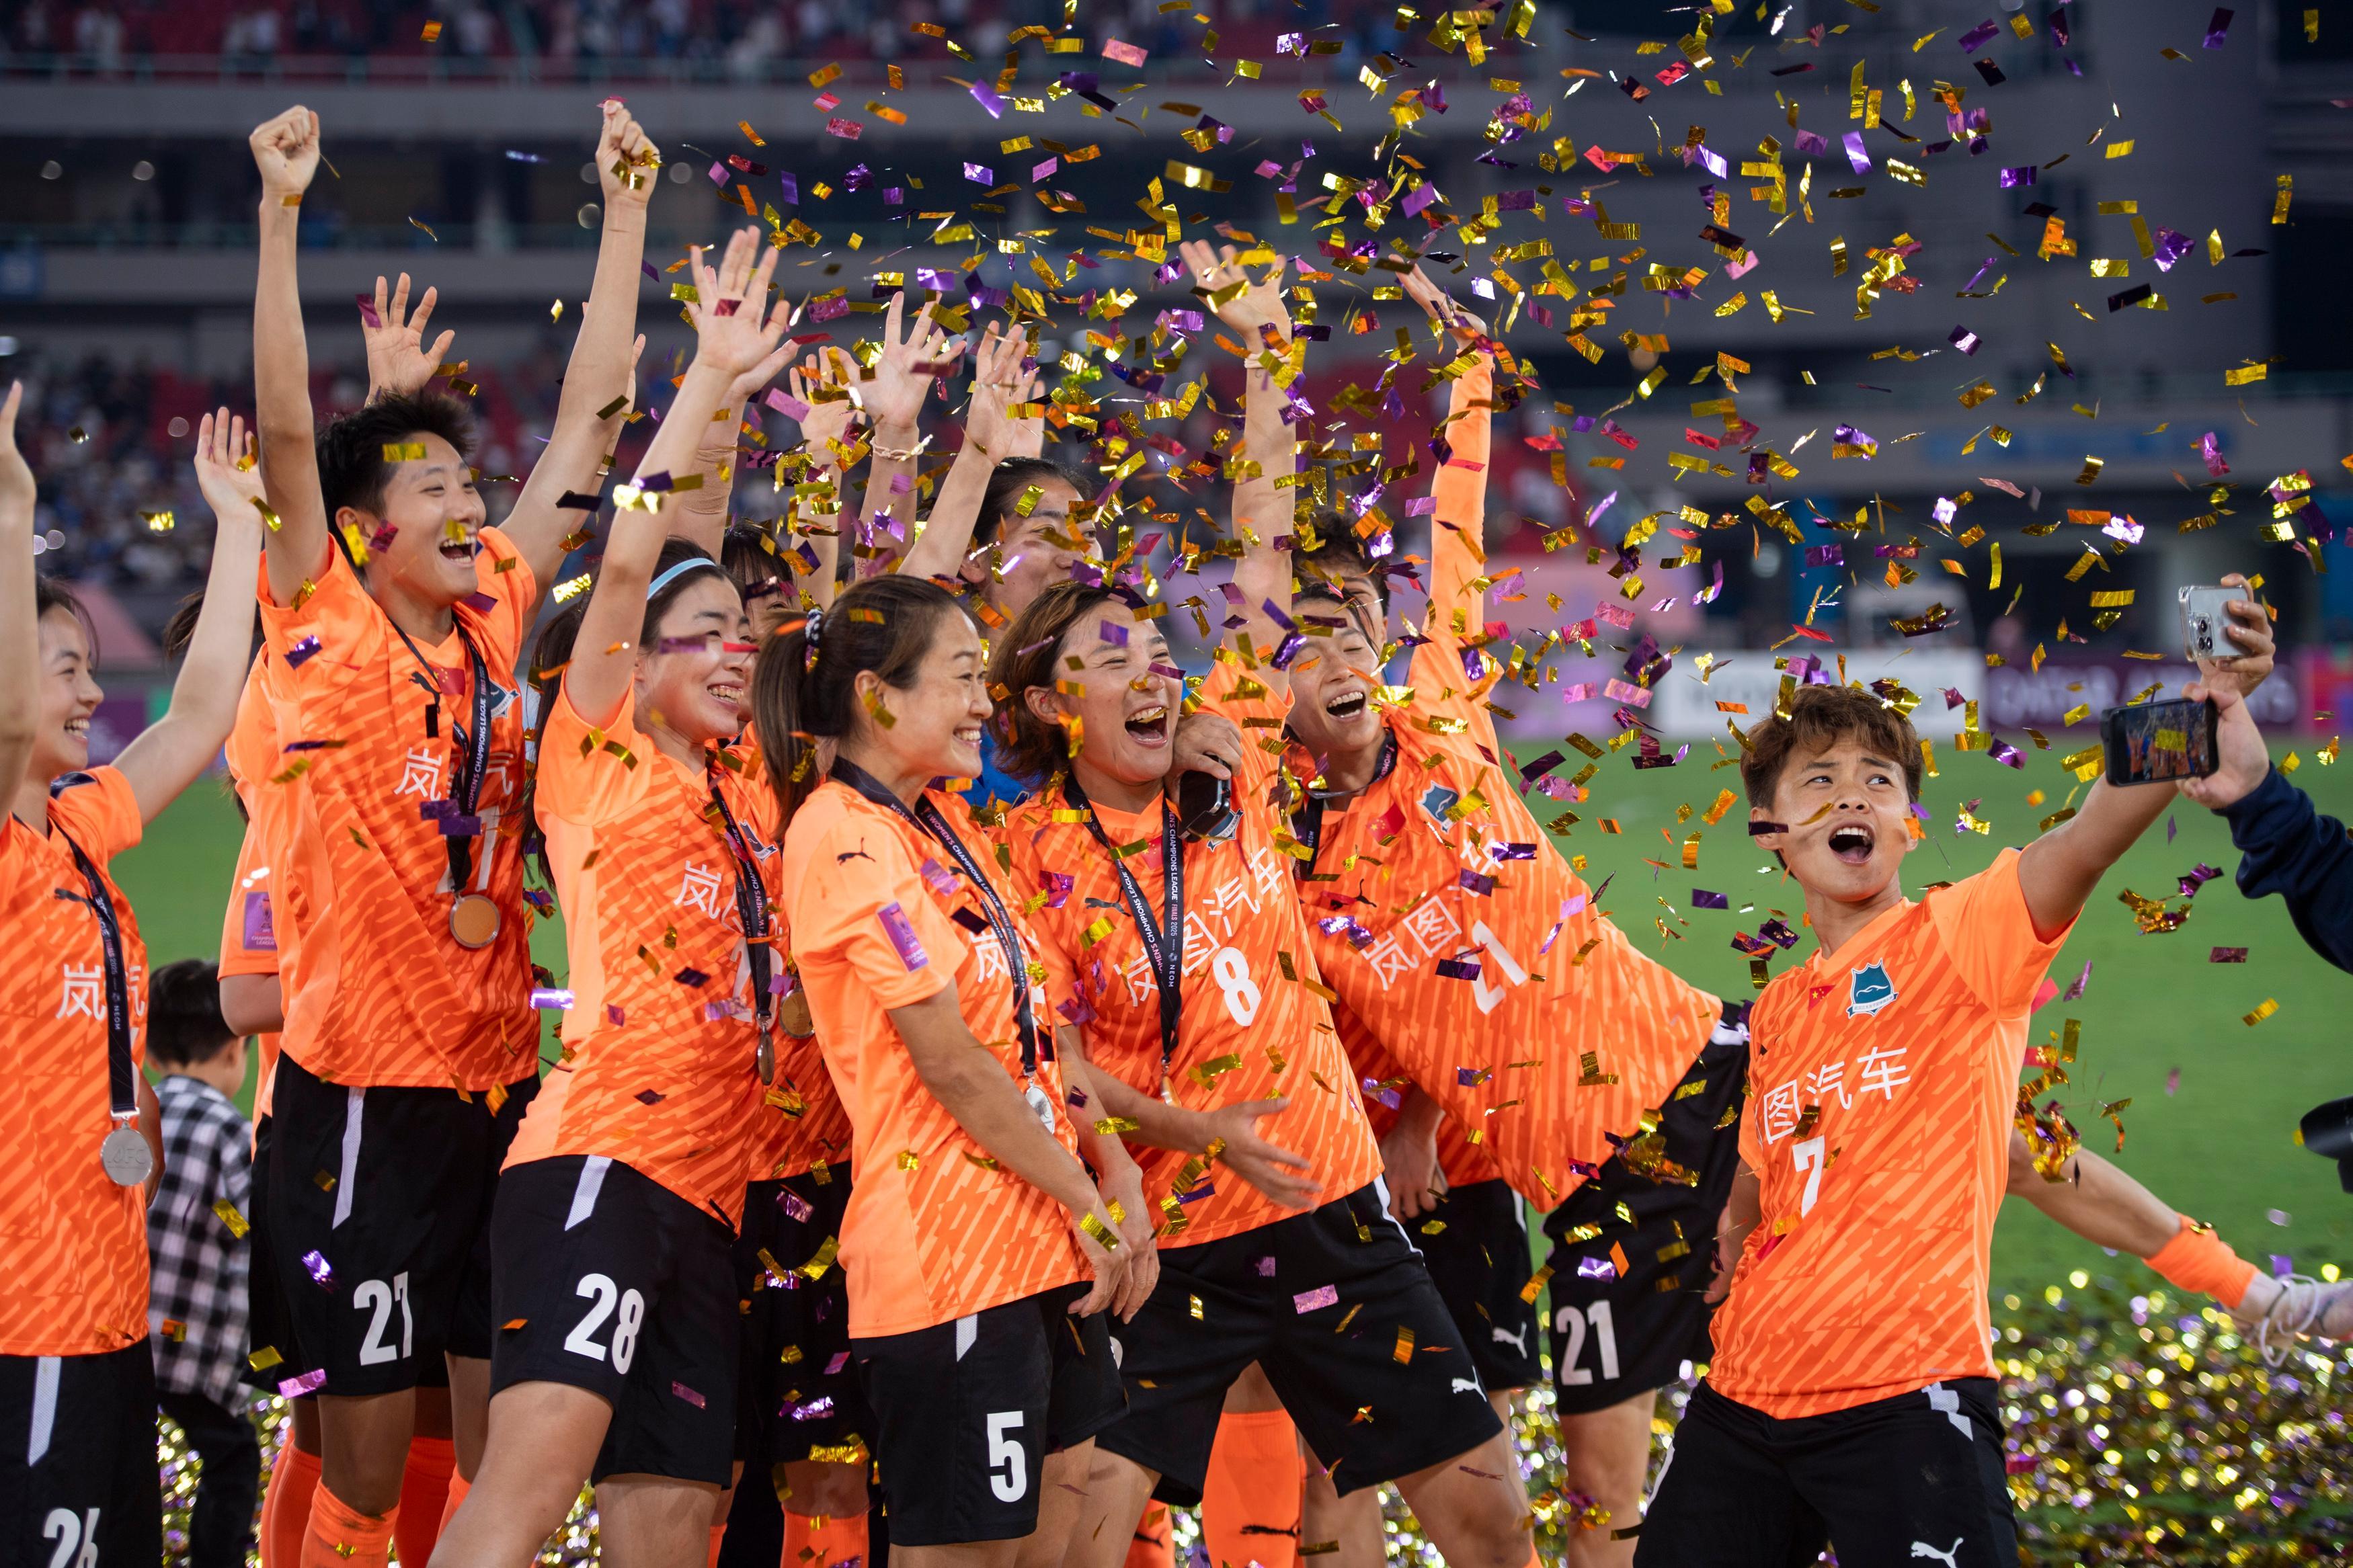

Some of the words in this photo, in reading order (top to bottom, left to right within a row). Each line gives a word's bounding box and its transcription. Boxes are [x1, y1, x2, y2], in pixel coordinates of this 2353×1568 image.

[468, 774, 480, 808] WOMEN'S
[475, 726, 486, 773] CHAMPIONS
[929, 816, 955, 846] WOMEN'S
[952, 845, 983, 883] CHAMPIONS
[981, 882, 1001, 908] LEAGUE
[1122, 871, 1138, 899] LEAGUE
[754, 890, 764, 927] WOMEN'S
[1134, 898, 1156, 943] CHAMPIONS
[113, 1005, 121, 1030] NEOM
[1212, 946, 1263, 1027] 8
[1756, 1046, 1911, 1145] 图汽车
[1792, 1134, 1825, 1219] 7
[354, 1271, 413, 1366] 27
[563, 1273, 645, 1375] 28
[1556, 1299, 1620, 1386] 21
[987, 1411, 1027, 1503] 5
